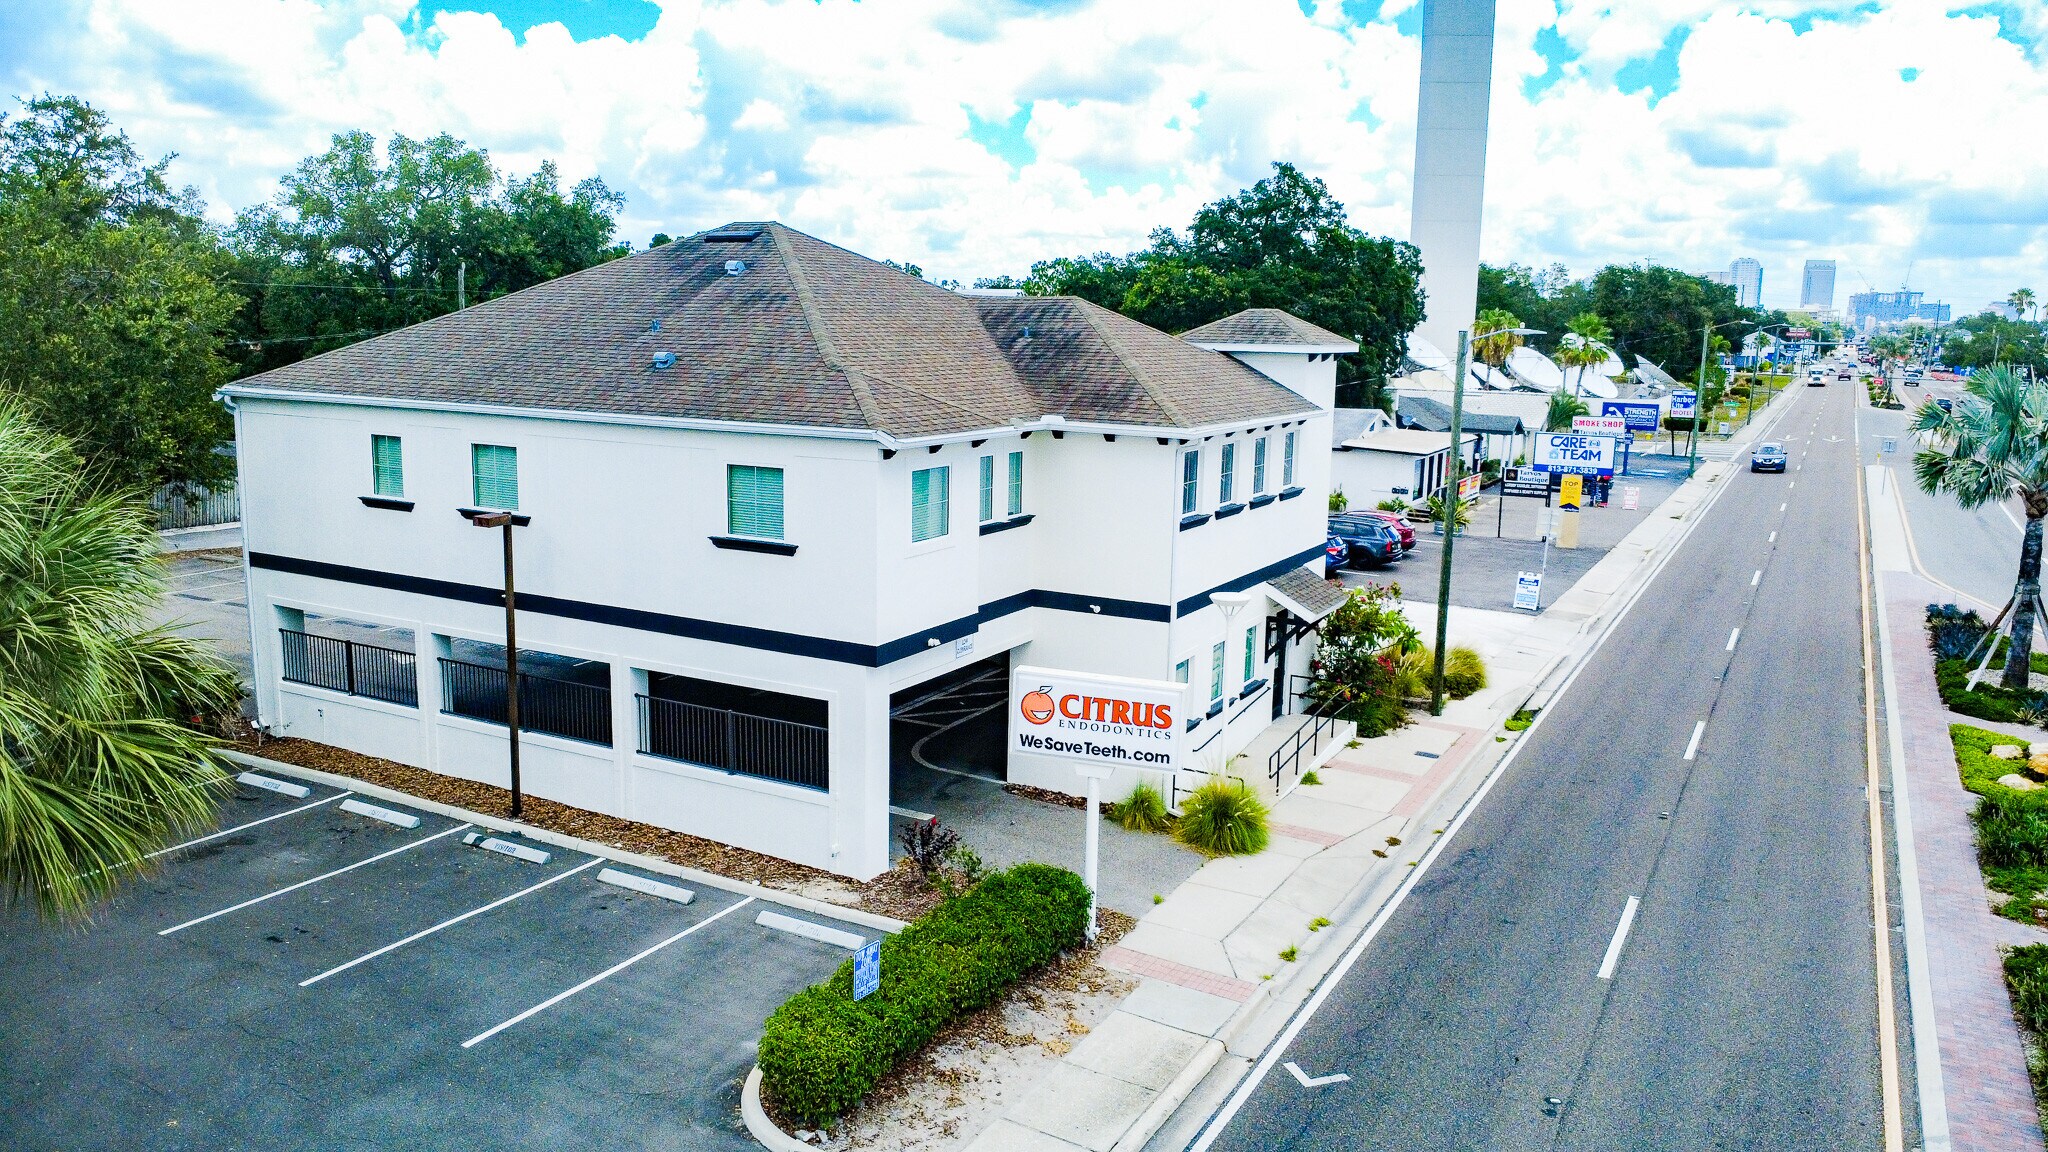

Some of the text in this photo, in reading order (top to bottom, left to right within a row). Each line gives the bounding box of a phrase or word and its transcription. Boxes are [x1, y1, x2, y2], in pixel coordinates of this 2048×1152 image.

[1573, 419, 1600, 427] SMOKE
[1602, 420, 1624, 428] SHOP
[1550, 435, 1588, 449] CARE
[1559, 448, 1602, 462] TEAM
[1519, 475, 1549, 484] Boutique
[1564, 480, 1579, 488] TOP
[1059, 694, 1173, 729] CITRUS
[1059, 719, 1171, 740] ENDODONTICS
[1019, 733, 1170, 764] WeSaveTeeth.com
[494, 842, 517, 854] VISITOR
